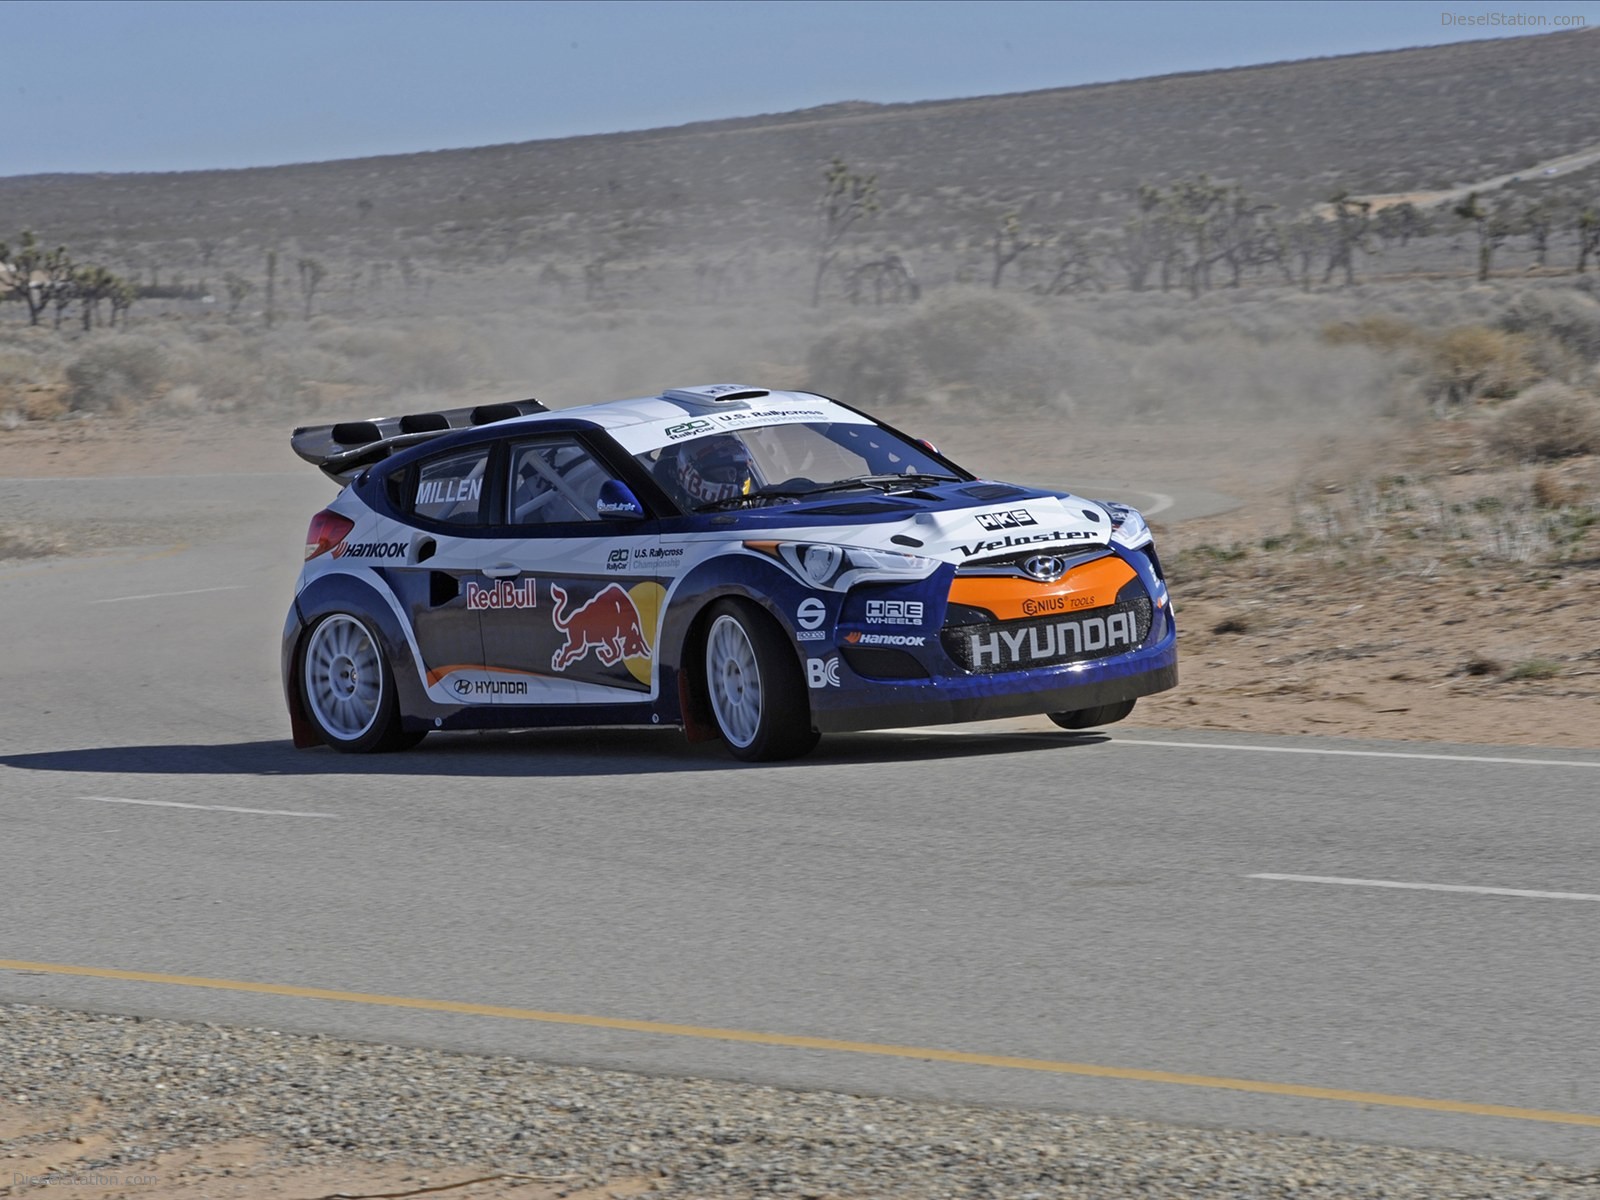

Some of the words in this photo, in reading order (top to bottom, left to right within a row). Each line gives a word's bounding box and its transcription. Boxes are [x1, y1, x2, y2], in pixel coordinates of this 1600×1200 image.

[719, 413, 750, 422] U.S.
[753, 409, 824, 418] Rallycross
[669, 426, 715, 440] RallyCar
[415, 478, 483, 505] MILLEN
[976, 509, 1038, 531] HKS
[951, 530, 1099, 557] Veloster
[634, 549, 648, 558] U.S.
[649, 547, 684, 559] Rallycross
[607, 562, 627, 571] RallyCar
[466, 581, 502, 610] Red
[502, 578, 537, 609] Bull
[1070, 595, 1095, 607] TOOLS
[866, 600, 924, 618] HRE
[866, 617, 923, 626] WHEELS
[971, 611, 1137, 668] HYUNDAI
[475, 681, 528, 695] HYUNDAI
